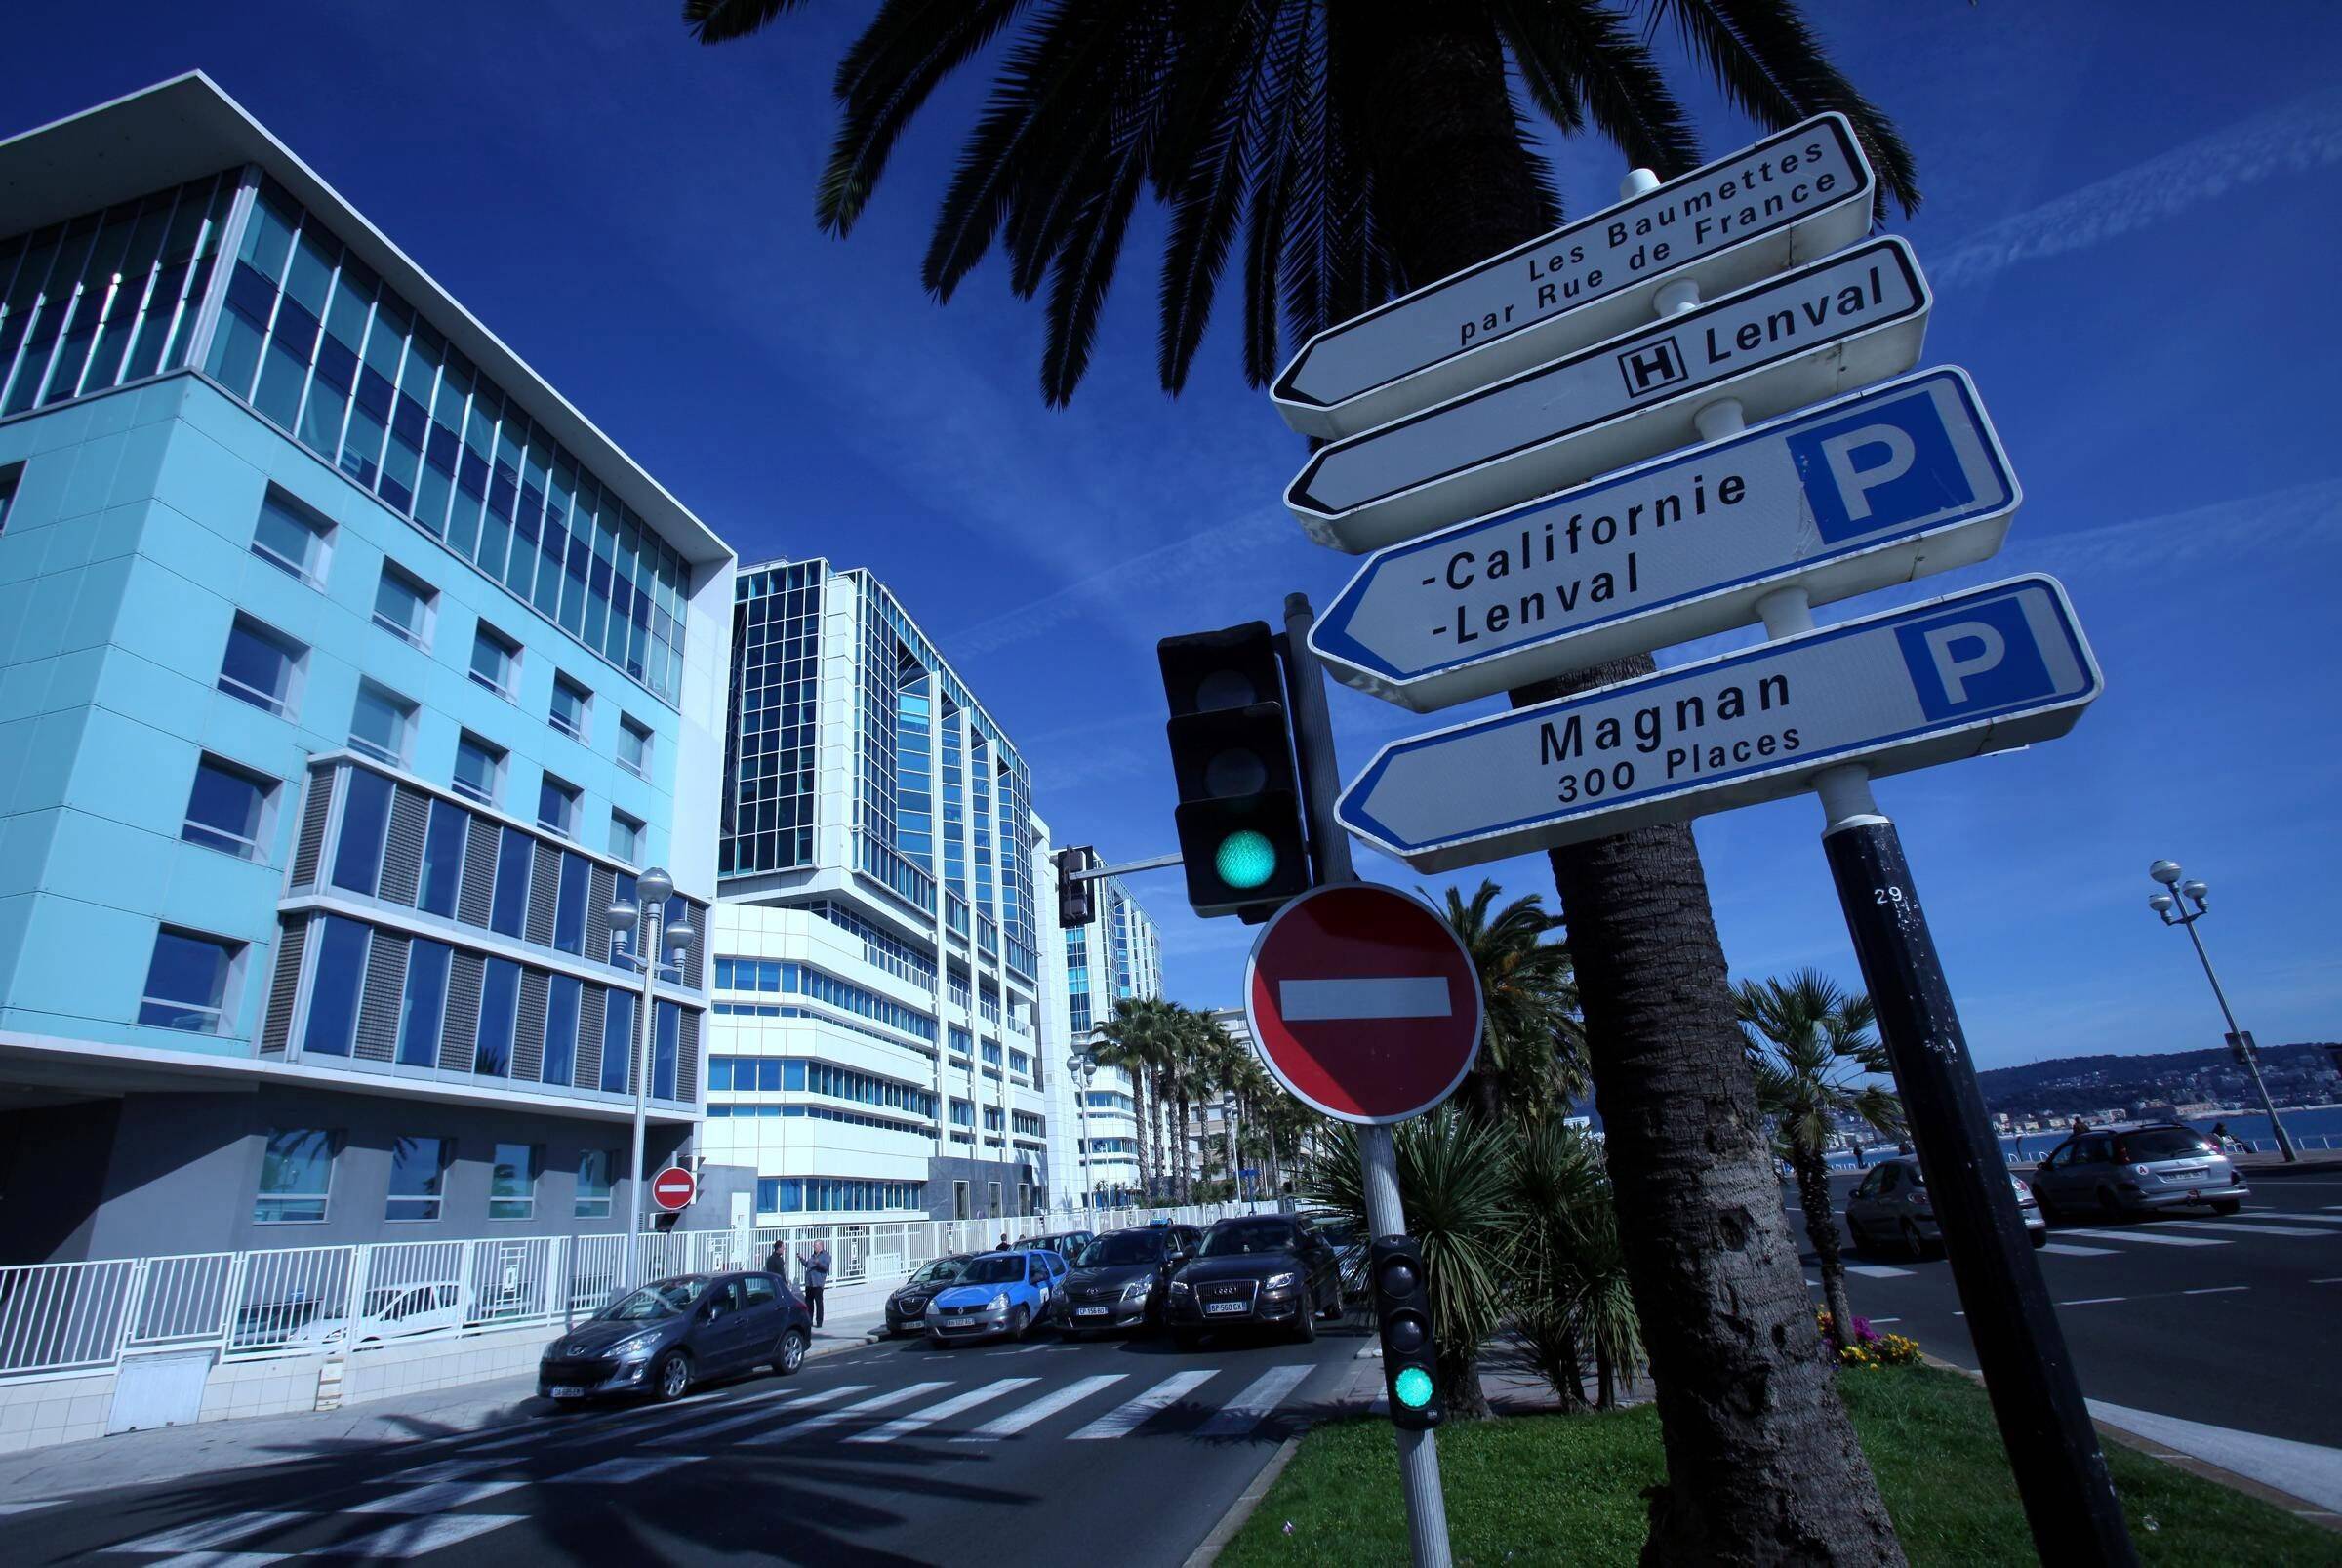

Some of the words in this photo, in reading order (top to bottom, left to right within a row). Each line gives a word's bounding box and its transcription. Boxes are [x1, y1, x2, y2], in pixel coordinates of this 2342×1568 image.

[1461, 303, 1514, 347] par
[1537, 269, 1603, 310] Rue
[1629, 242, 1671, 271] de
[1694, 173, 1836, 246] France
[1529, 246, 1585, 282] Les
[1607, 143, 1823, 249] Baumettes
[1706, 266, 1882, 365] Lenval
[1820, 423, 1917, 522] P
[1923, 621, 2005, 705] P
[1540, 674, 1790, 766] Magnan
[1557, 760, 1635, 804] 300
[1666, 728, 1800, 780] Places
[1874, 886, 1903, 905] 29
